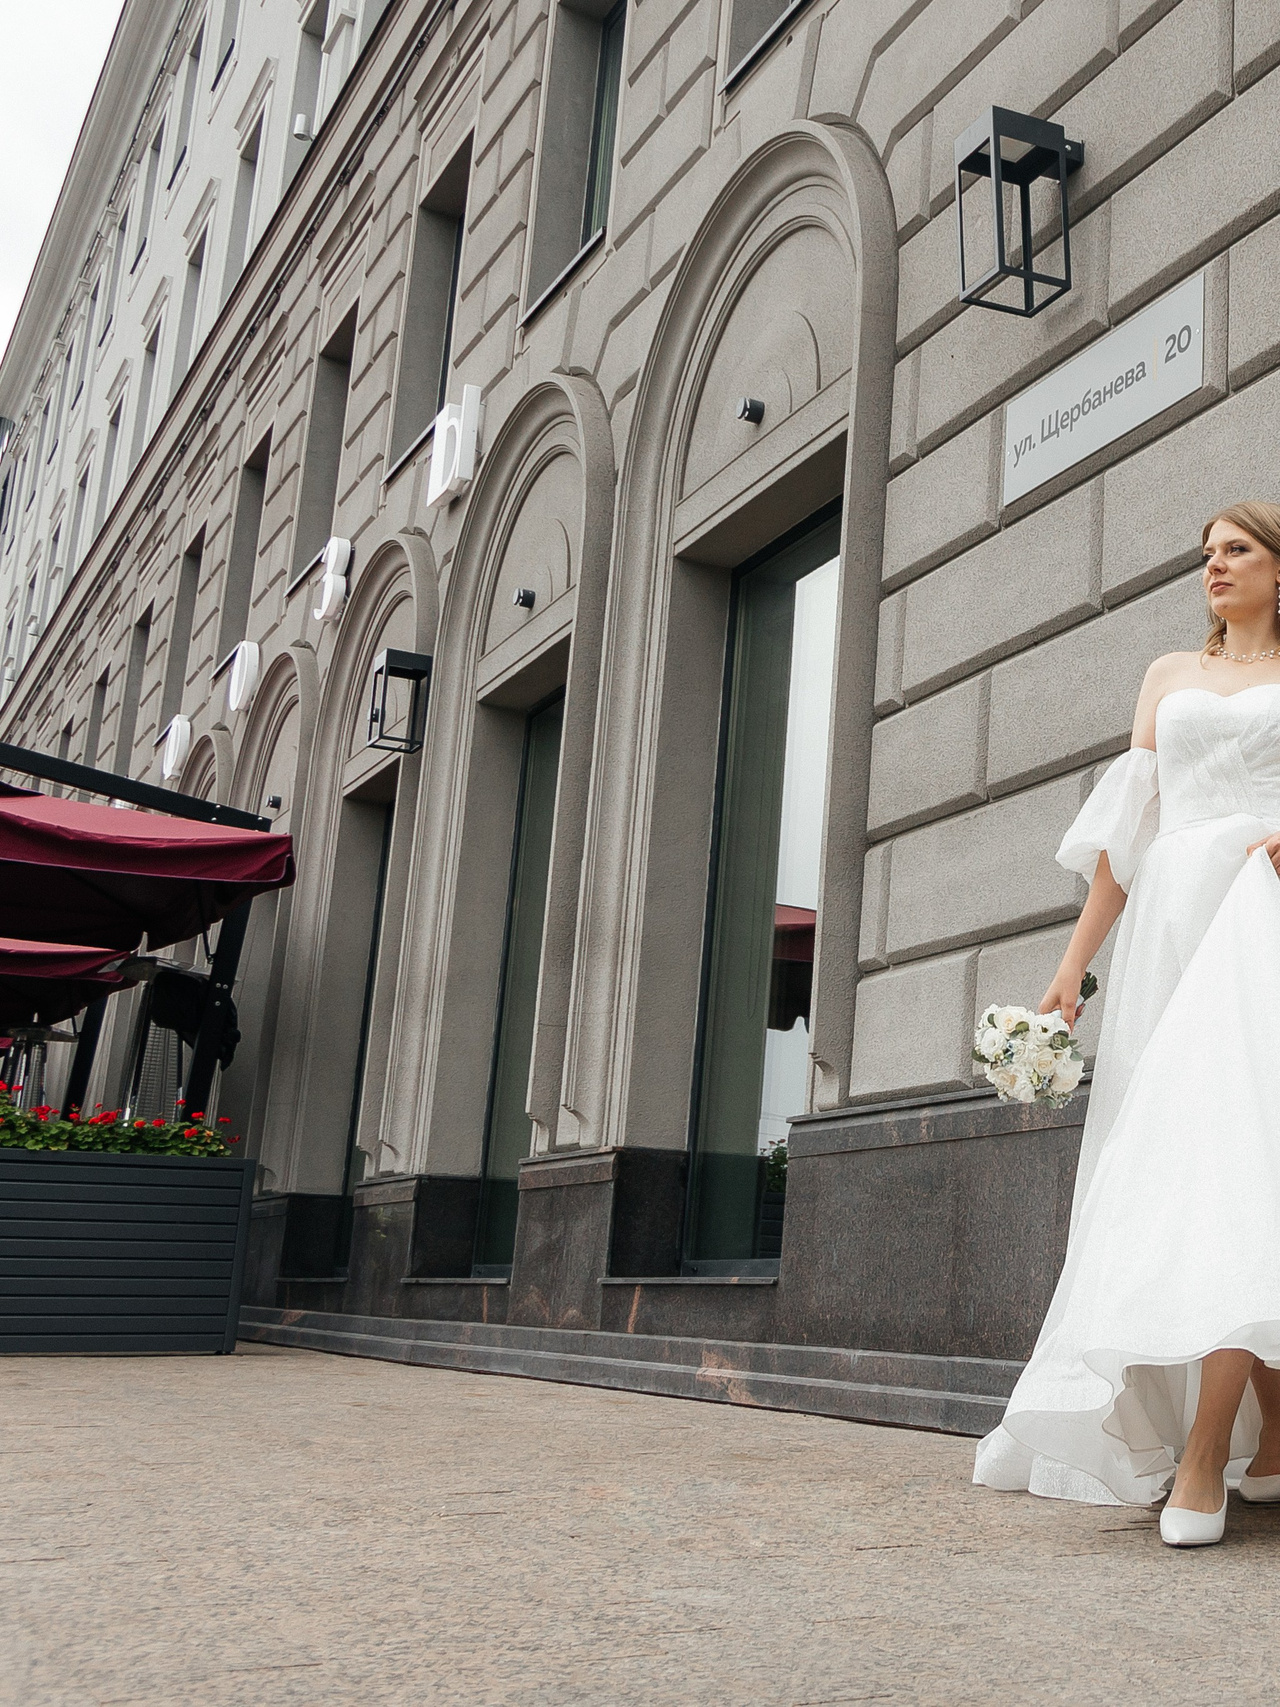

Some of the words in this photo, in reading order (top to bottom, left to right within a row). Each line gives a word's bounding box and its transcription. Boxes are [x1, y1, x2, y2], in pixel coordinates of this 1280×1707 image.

[1013, 434, 1036, 468] ул.
[1040, 360, 1147, 444] Щербанева
[1164, 324, 1192, 364] 20
